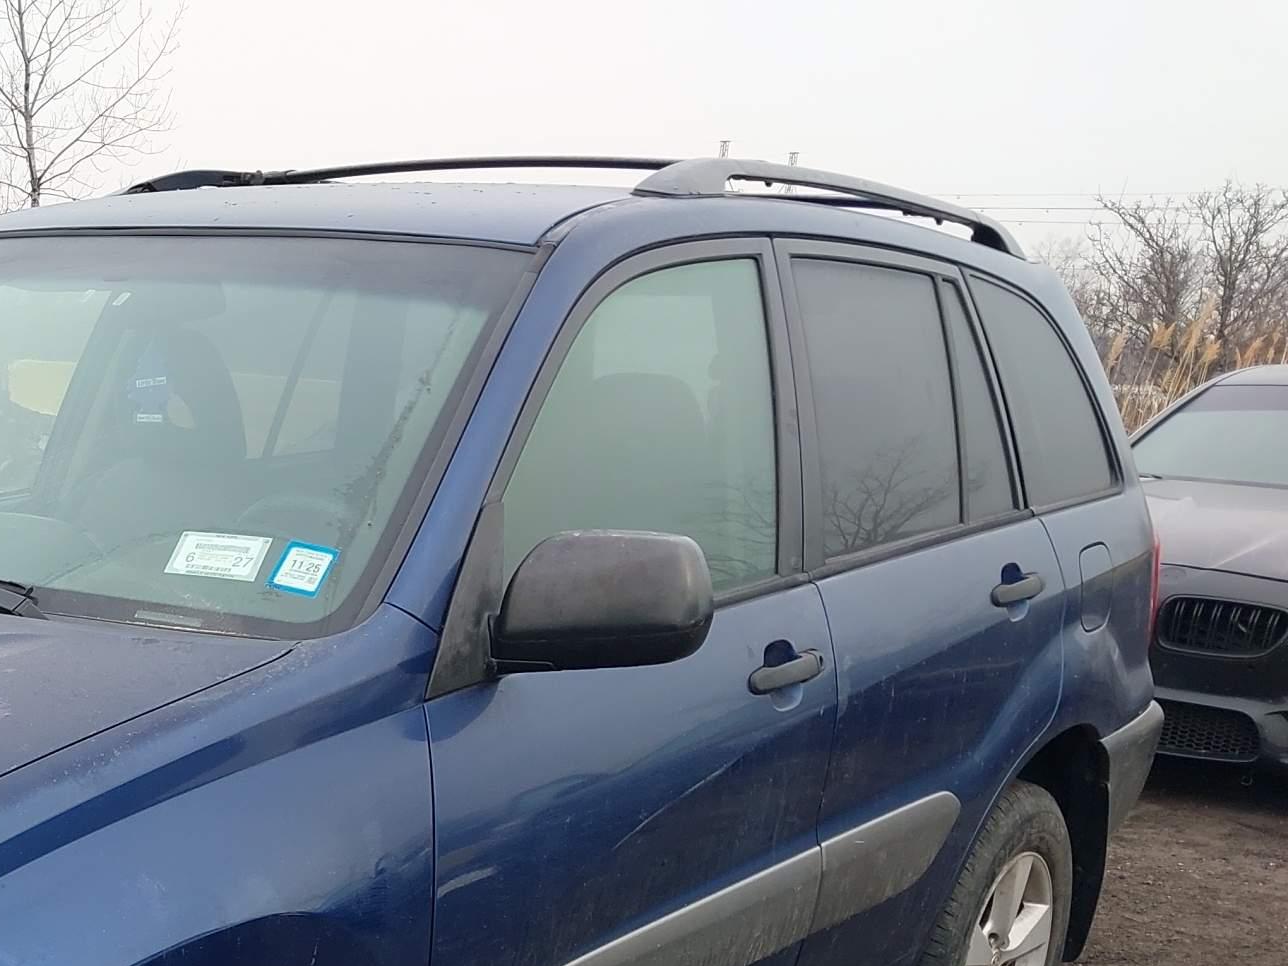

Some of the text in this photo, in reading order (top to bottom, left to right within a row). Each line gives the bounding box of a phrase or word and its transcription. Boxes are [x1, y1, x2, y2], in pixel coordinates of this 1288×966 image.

[185, 551, 196, 563] 6
[231, 556, 254, 568] 27
[305, 562, 322, 573] 25
